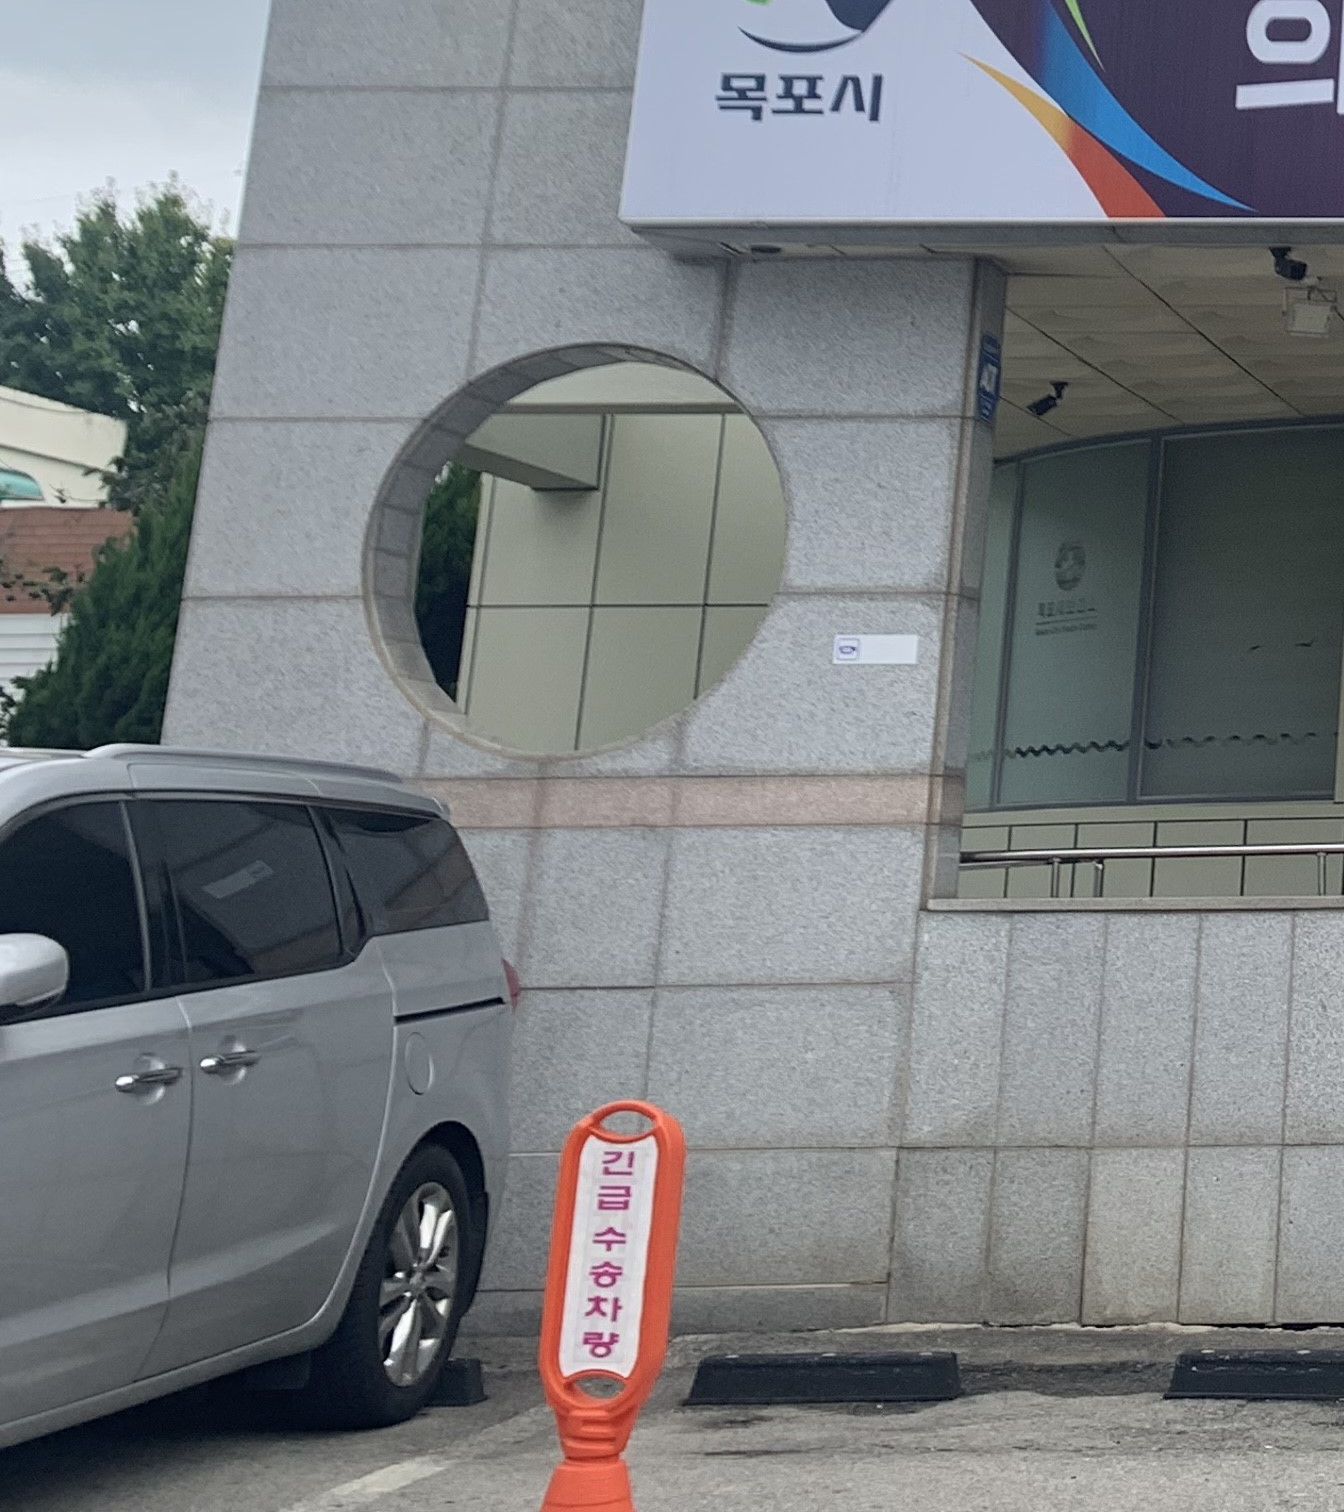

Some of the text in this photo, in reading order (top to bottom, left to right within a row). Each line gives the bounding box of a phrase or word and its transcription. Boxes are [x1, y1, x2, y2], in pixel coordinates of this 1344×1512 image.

[715, 73, 884, 123] 목포시
[582, 1150, 636, 1358] 긴급 수송차량
